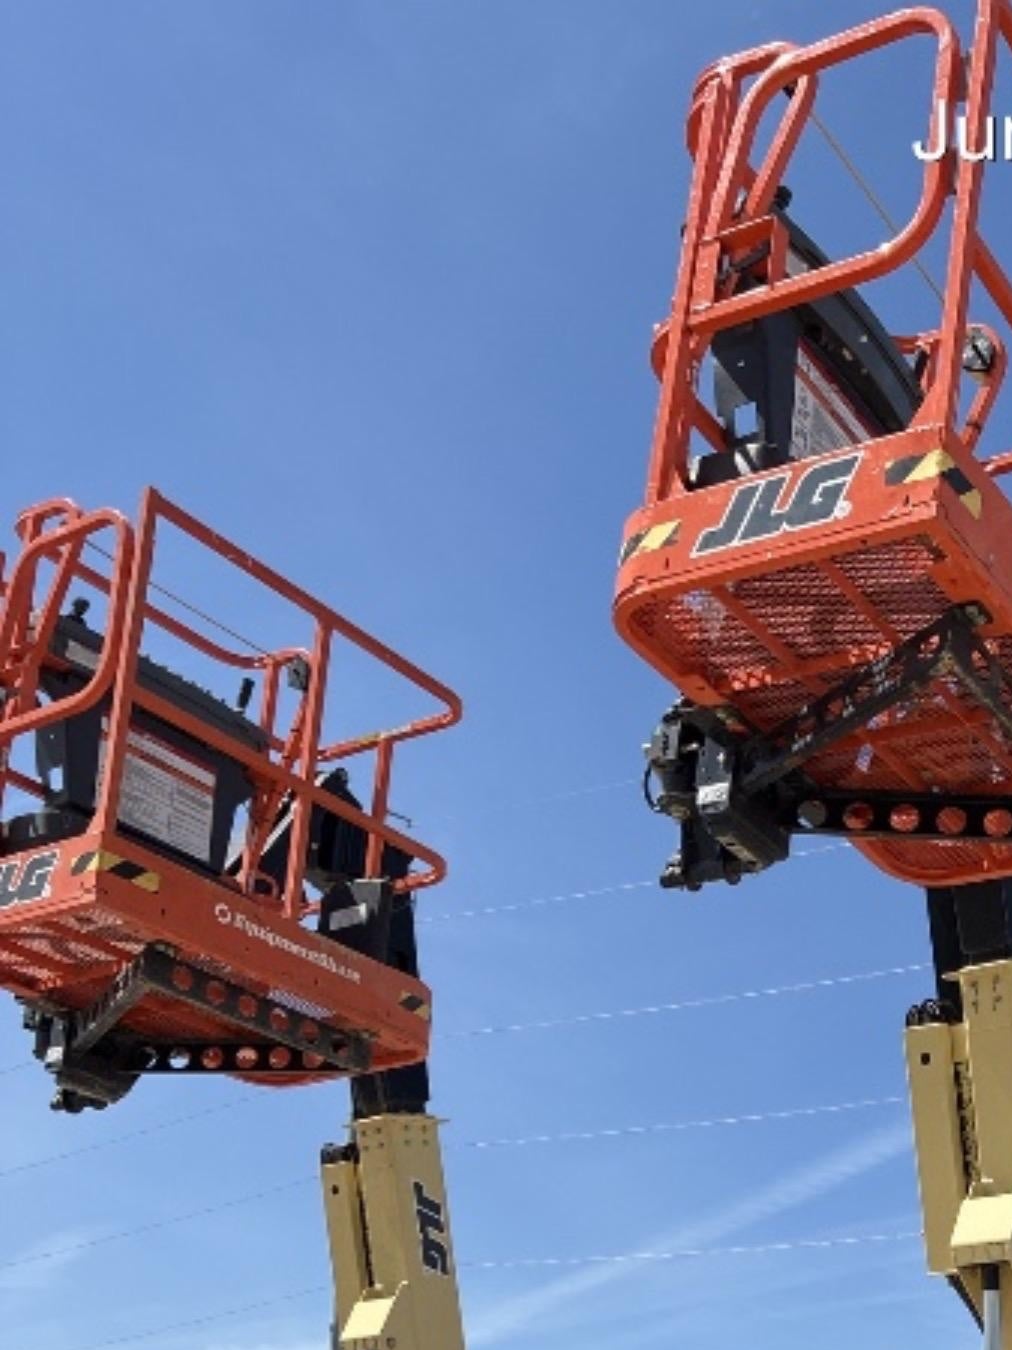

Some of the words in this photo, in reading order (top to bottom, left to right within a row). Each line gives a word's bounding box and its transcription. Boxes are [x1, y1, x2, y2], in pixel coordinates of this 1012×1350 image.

[690, 451, 866, 558] JLG
[0, 850, 58, 909] LG
[412, 1179, 449, 1276] JLG
